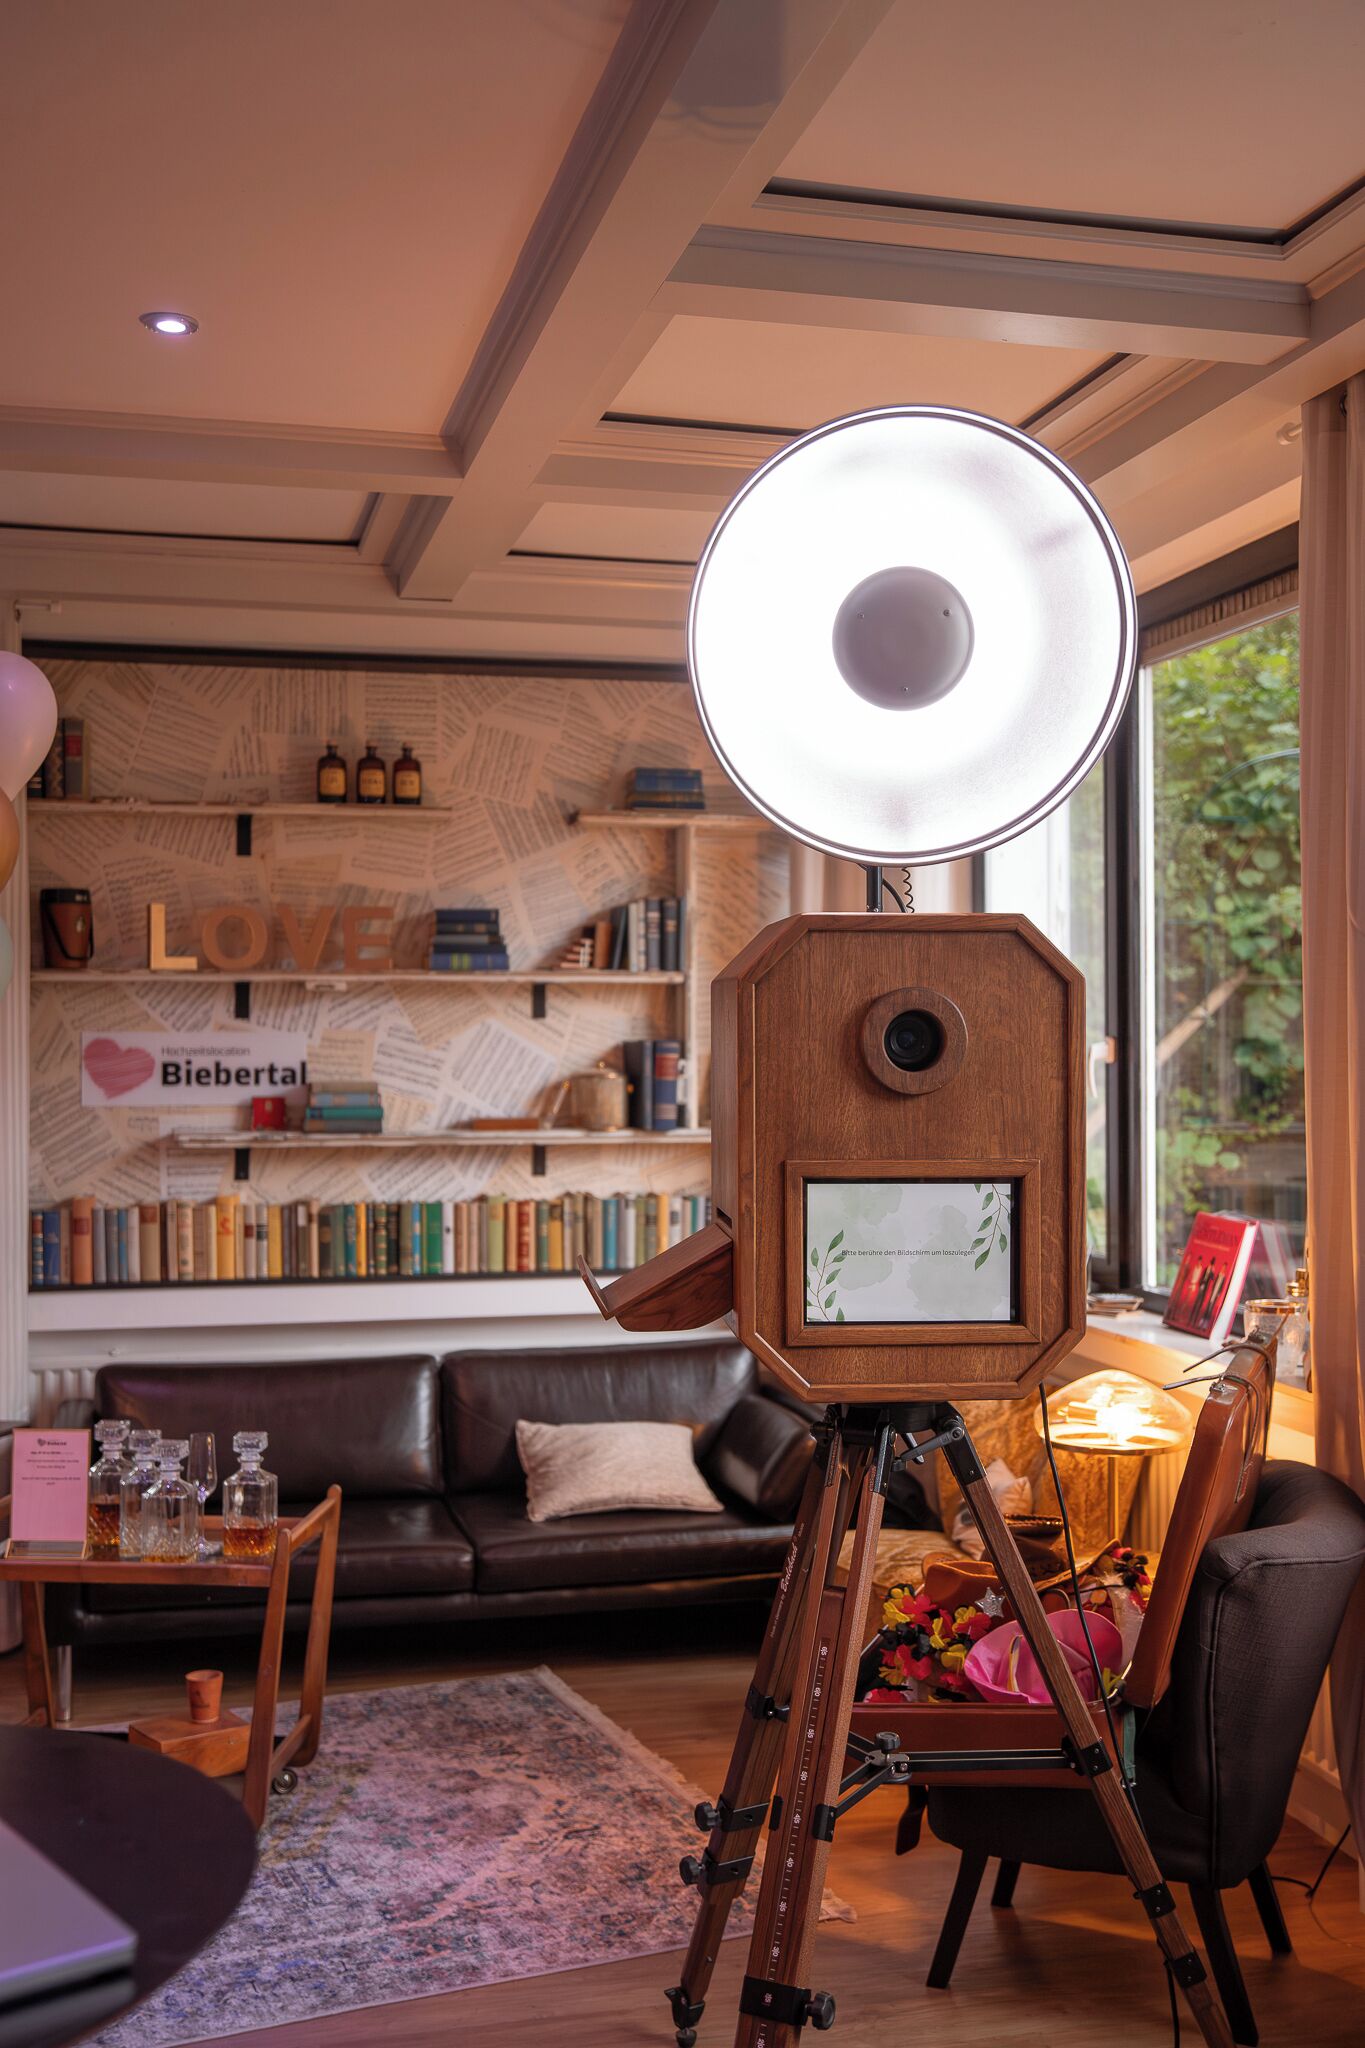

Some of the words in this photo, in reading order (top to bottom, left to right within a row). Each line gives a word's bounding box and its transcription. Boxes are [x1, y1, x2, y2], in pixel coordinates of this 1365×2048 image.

[149, 902, 394, 973] LOVE
[161, 1060, 308, 1087] Biebertal
[942, 1249, 976, 1257] loszulegen
